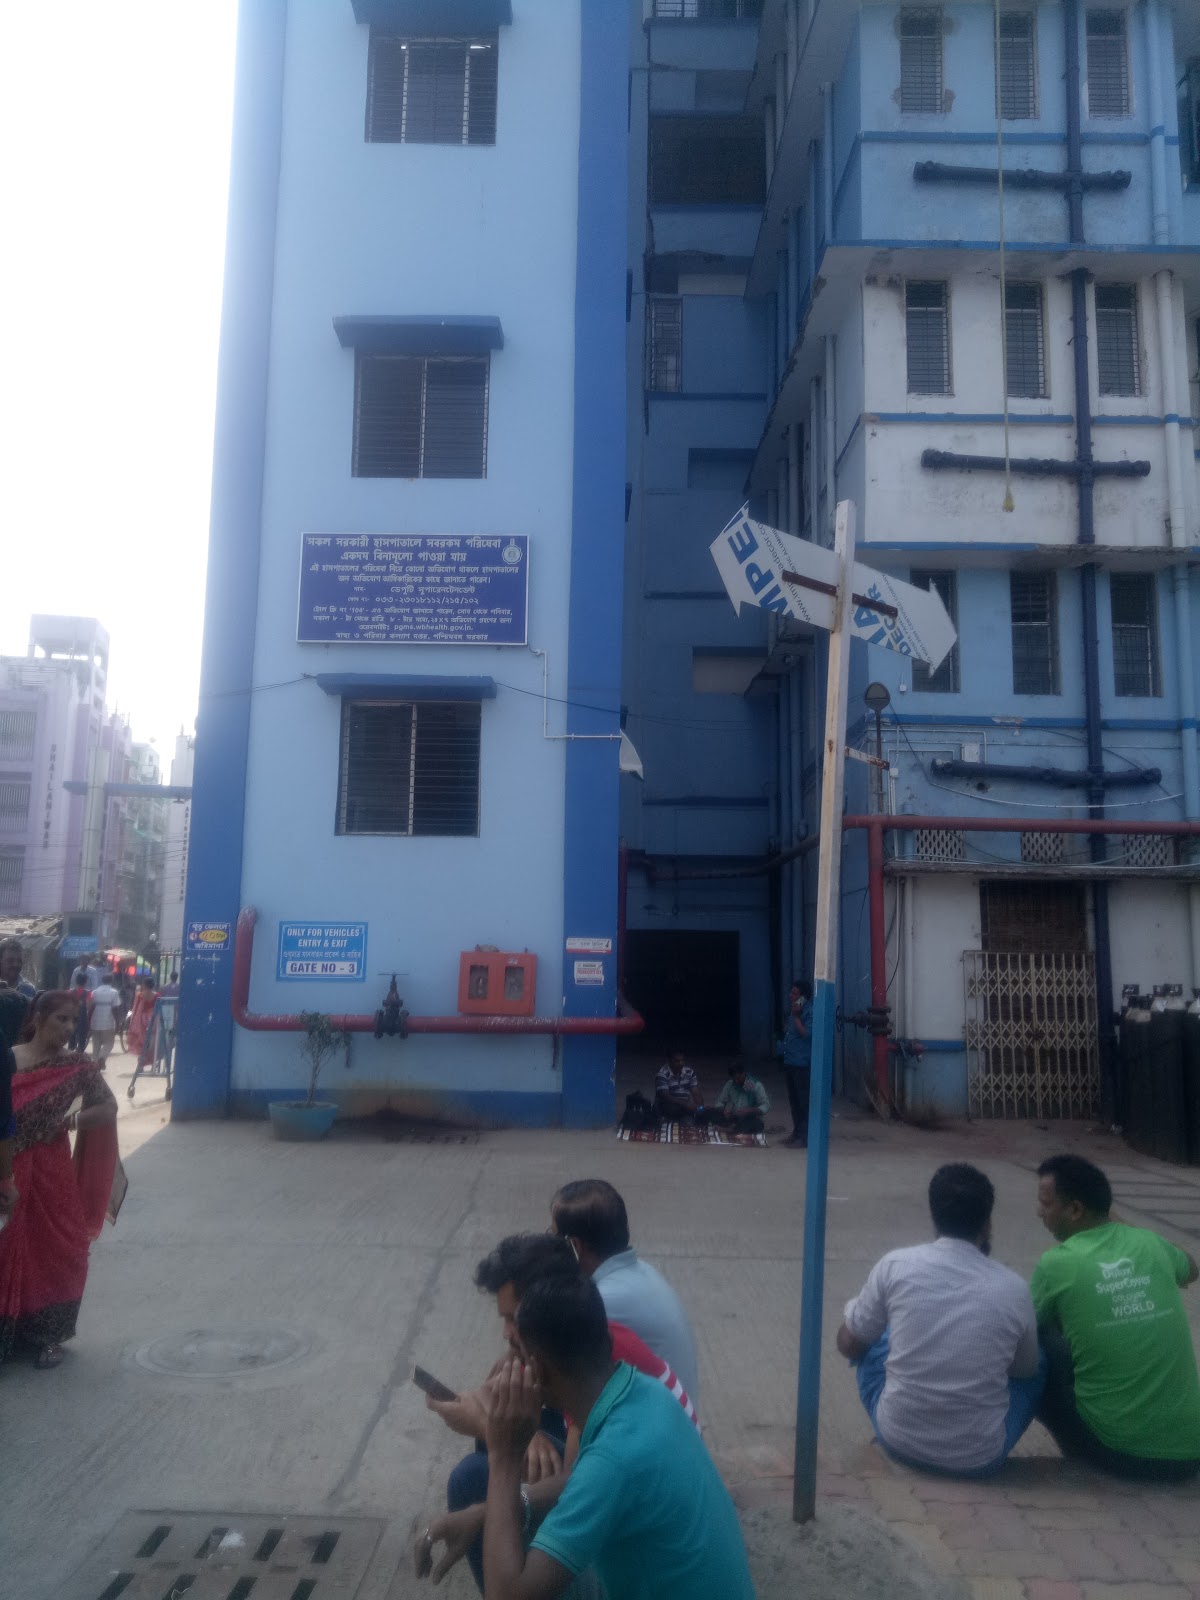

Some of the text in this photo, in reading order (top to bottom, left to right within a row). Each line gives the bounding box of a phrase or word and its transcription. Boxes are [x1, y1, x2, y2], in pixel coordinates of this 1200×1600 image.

[306, 535, 502, 548] সকল সরকারী হাসপাতালে সবরকম পরিষেবা
[340, 549, 467, 564] একদম বিনামূল্যে পাওয়া যায়
[310, 563, 319, 572] এই
[362, 563, 386, 572] পরিষেবা
[428, 564, 456, 573] অভিযোগ
[481, 566, 519, 574] হাসপাতালের
[352, 573, 381, 582] অভিযোগ
[390, 584, 414, 595] ডেপুটি
[287, 928, 360, 937] ONLY FOR VEHICLES
[298, 939, 348, 947] ENTRY & EXIT
[290, 962, 317, 973] GATE
[321, 963, 337, 973] NO
[348, 963, 355, 973] 3
[1095, 1275, 1151, 1294] SuperCover
[1111, 1301, 1155, 1317] WORLD
